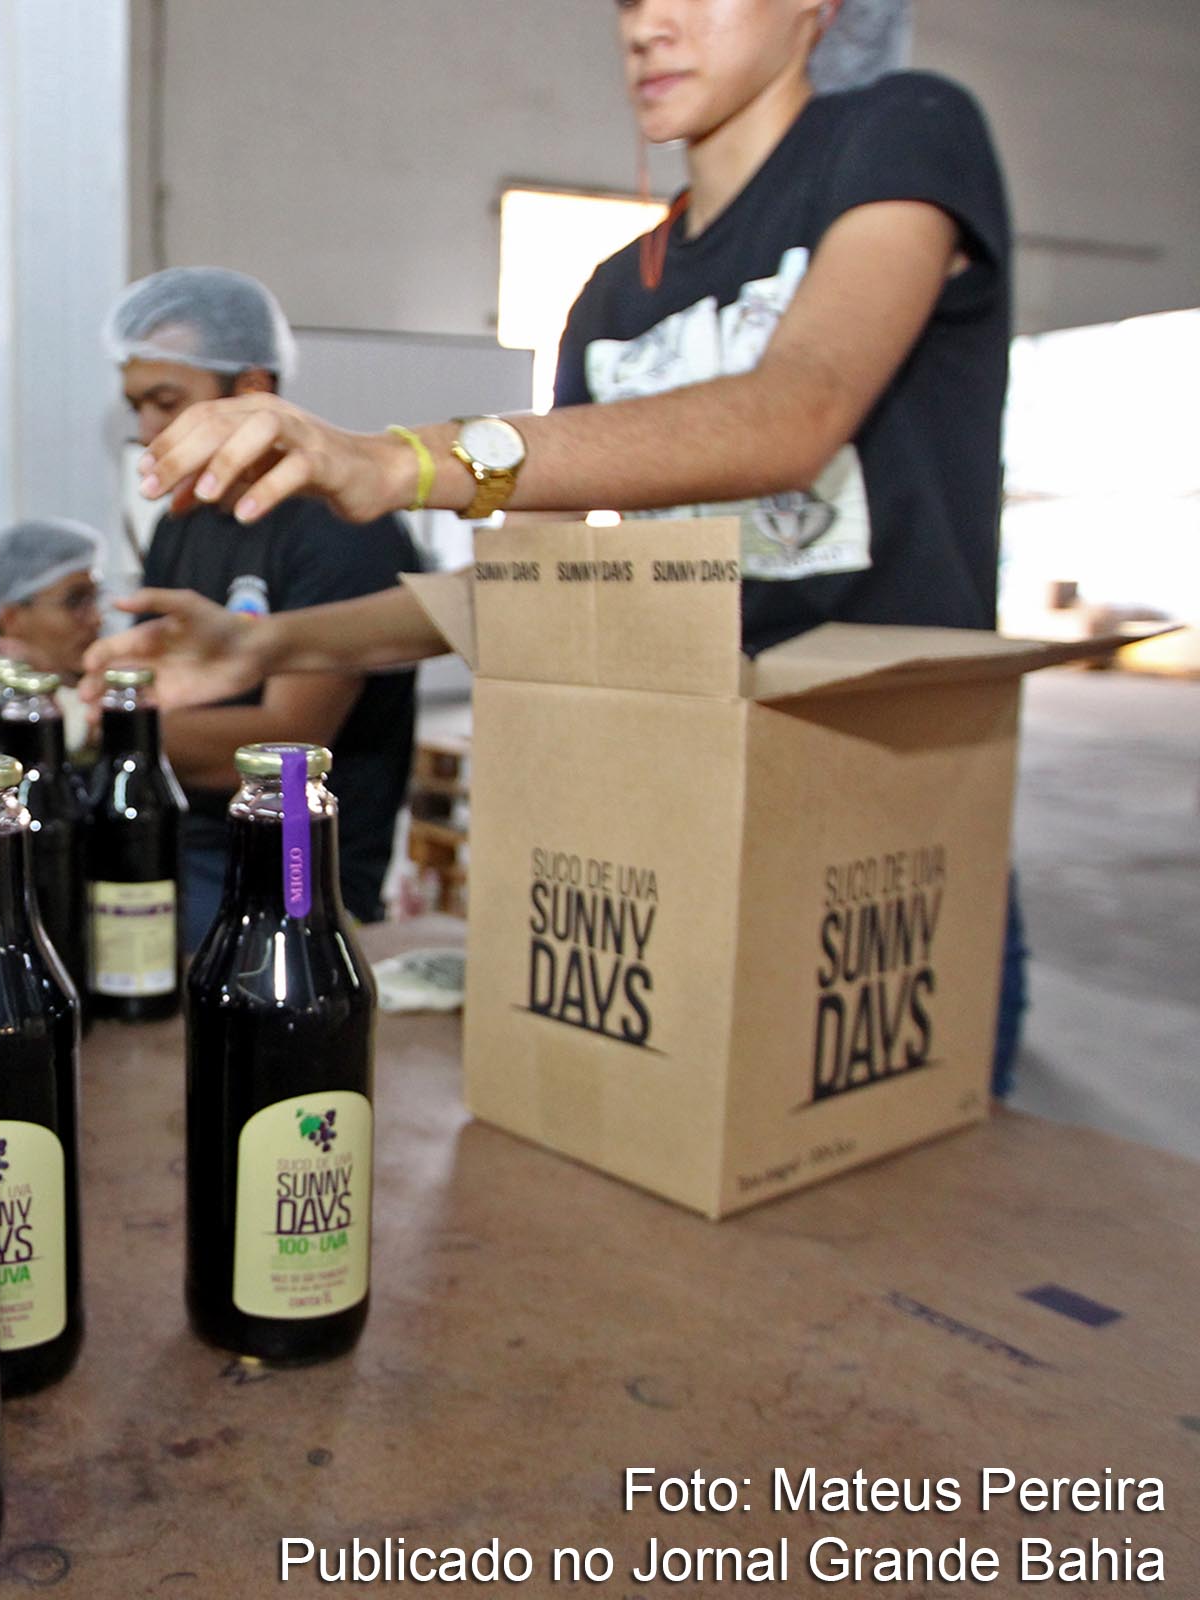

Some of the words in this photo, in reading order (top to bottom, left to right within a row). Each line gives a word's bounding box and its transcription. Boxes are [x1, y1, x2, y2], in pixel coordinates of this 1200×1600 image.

[476, 560, 508, 582] SUNNY
[557, 560, 598, 582] SUNNY
[653, 560, 696, 582] SUNNY
[701, 559, 738, 583] DAYS
[290, 847, 303, 904] MIOLO
[532, 847, 581, 886] SUCO
[586, 858, 613, 892] DE
[617, 864, 660, 903] UVA
[530, 880, 656, 960] SUNNY
[818, 887, 944, 989] SUNNY
[529, 935, 654, 1046] DAYS
[812, 966, 935, 1102] DAYS
[276, 1164, 353, 1198] SUNNY
[276, 1191, 352, 1235] DAYS
[319, 1230, 348, 1253] UVA
